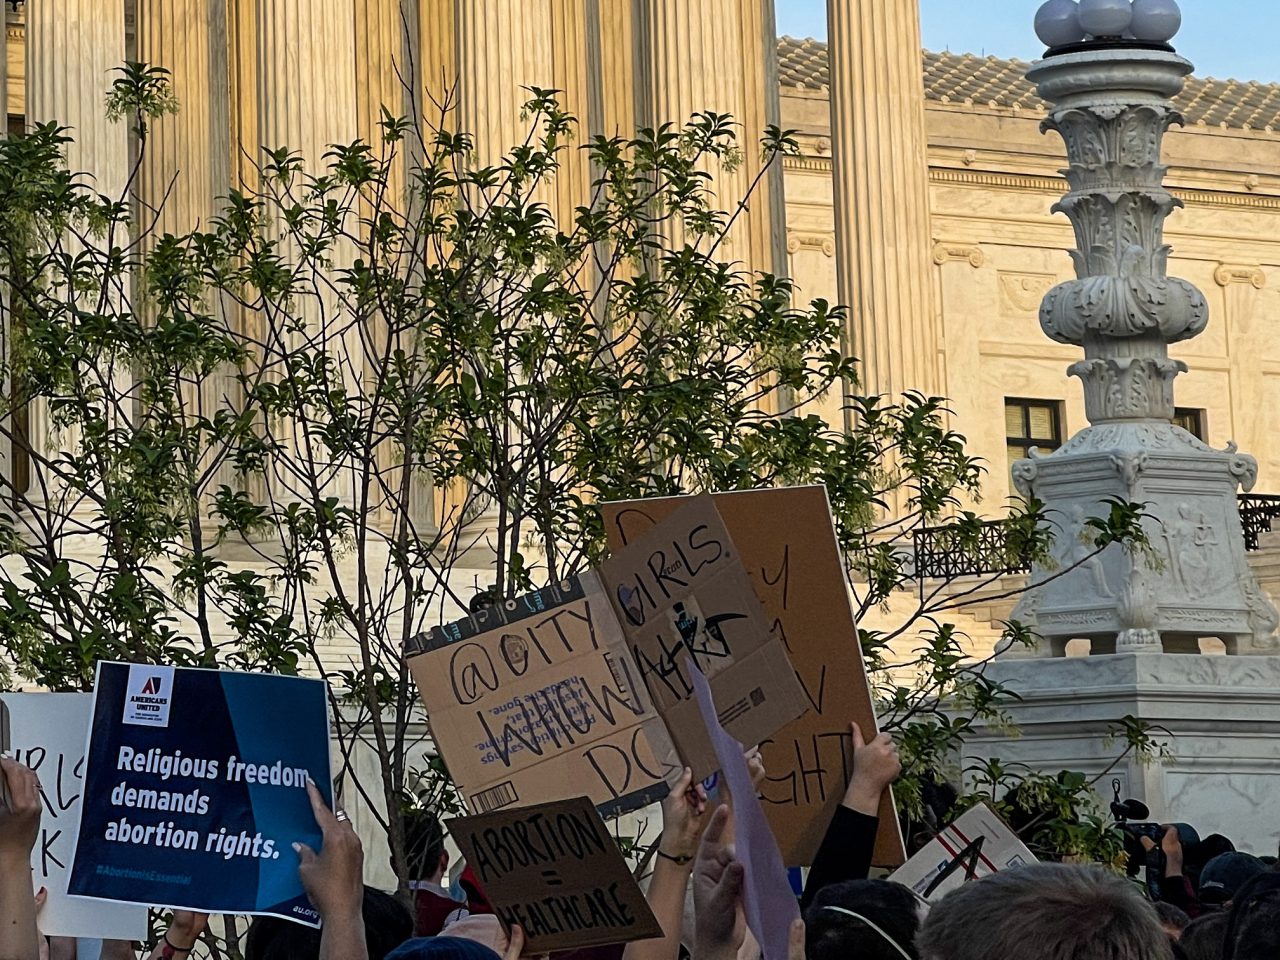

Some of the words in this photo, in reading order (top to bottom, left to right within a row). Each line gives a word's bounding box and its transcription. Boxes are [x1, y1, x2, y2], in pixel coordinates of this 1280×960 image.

[130, 696, 168, 705] AMERICANS
[136, 704, 160, 712] UNITED
[117, 745, 219, 781] Religious
[227, 755, 310, 789] freedom
[111, 781, 210, 815] demands
[105, 817, 199, 851] abortion
[205, 827, 281, 860] rights.
[470, 810, 608, 883] ABORTION
[292, 904, 320, 920] au.org
[496, 882, 636, 939] HEALTHCARE
